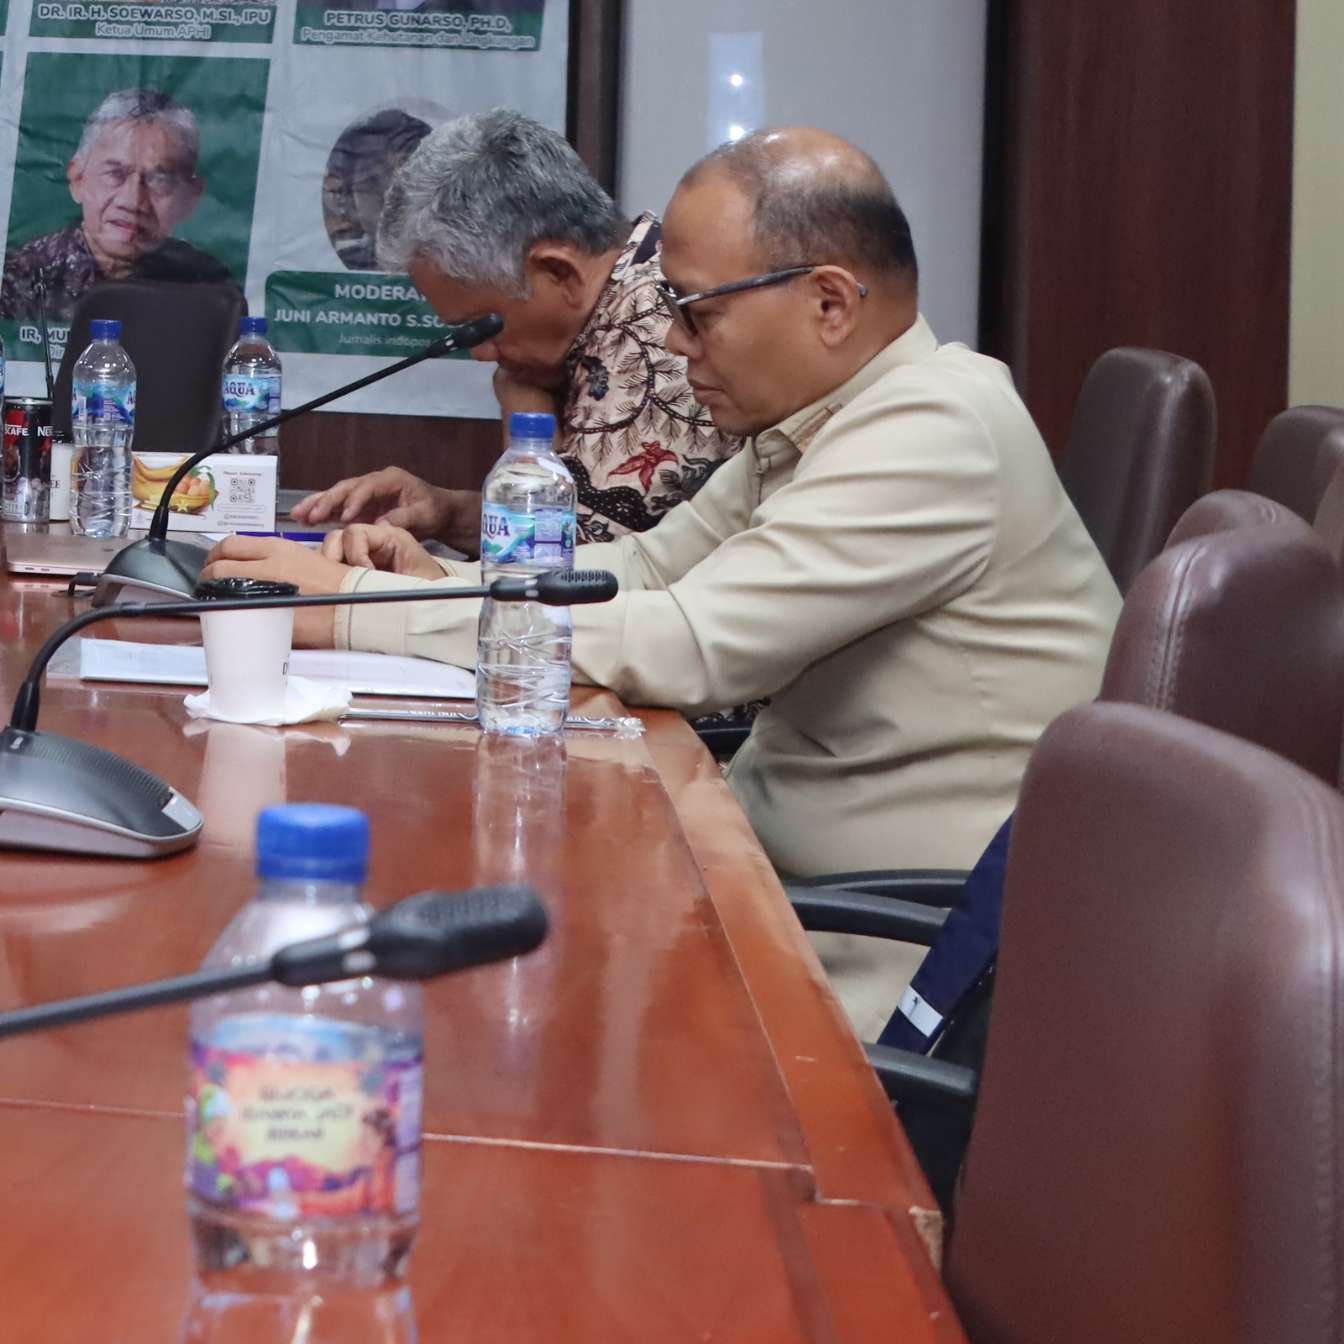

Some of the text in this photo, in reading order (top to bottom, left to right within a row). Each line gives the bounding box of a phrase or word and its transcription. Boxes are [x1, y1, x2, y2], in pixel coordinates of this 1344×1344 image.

[38, 4, 64, 19] DR.
[68, 5, 86, 19] IR.
[90, 6, 107, 20] H.
[109, 6, 199, 23] SOEWARSO,
[243, 10, 271, 24] IPU
[324, 11, 386, 27] PETRUS
[96, 23, 133, 36] Ketua
[135, 24, 176, 37] Umum
[301, 27, 365, 44] Pengamat
[366, 29, 433, 44] Kehutanan
[436, 30, 459, 45] dan
[335, 284, 427, 301] MODERA
[274, 309, 310, 324] JUNI
[315, 310, 402, 327] ARMANTO
[338, 334, 382, 346] Jurnalis
